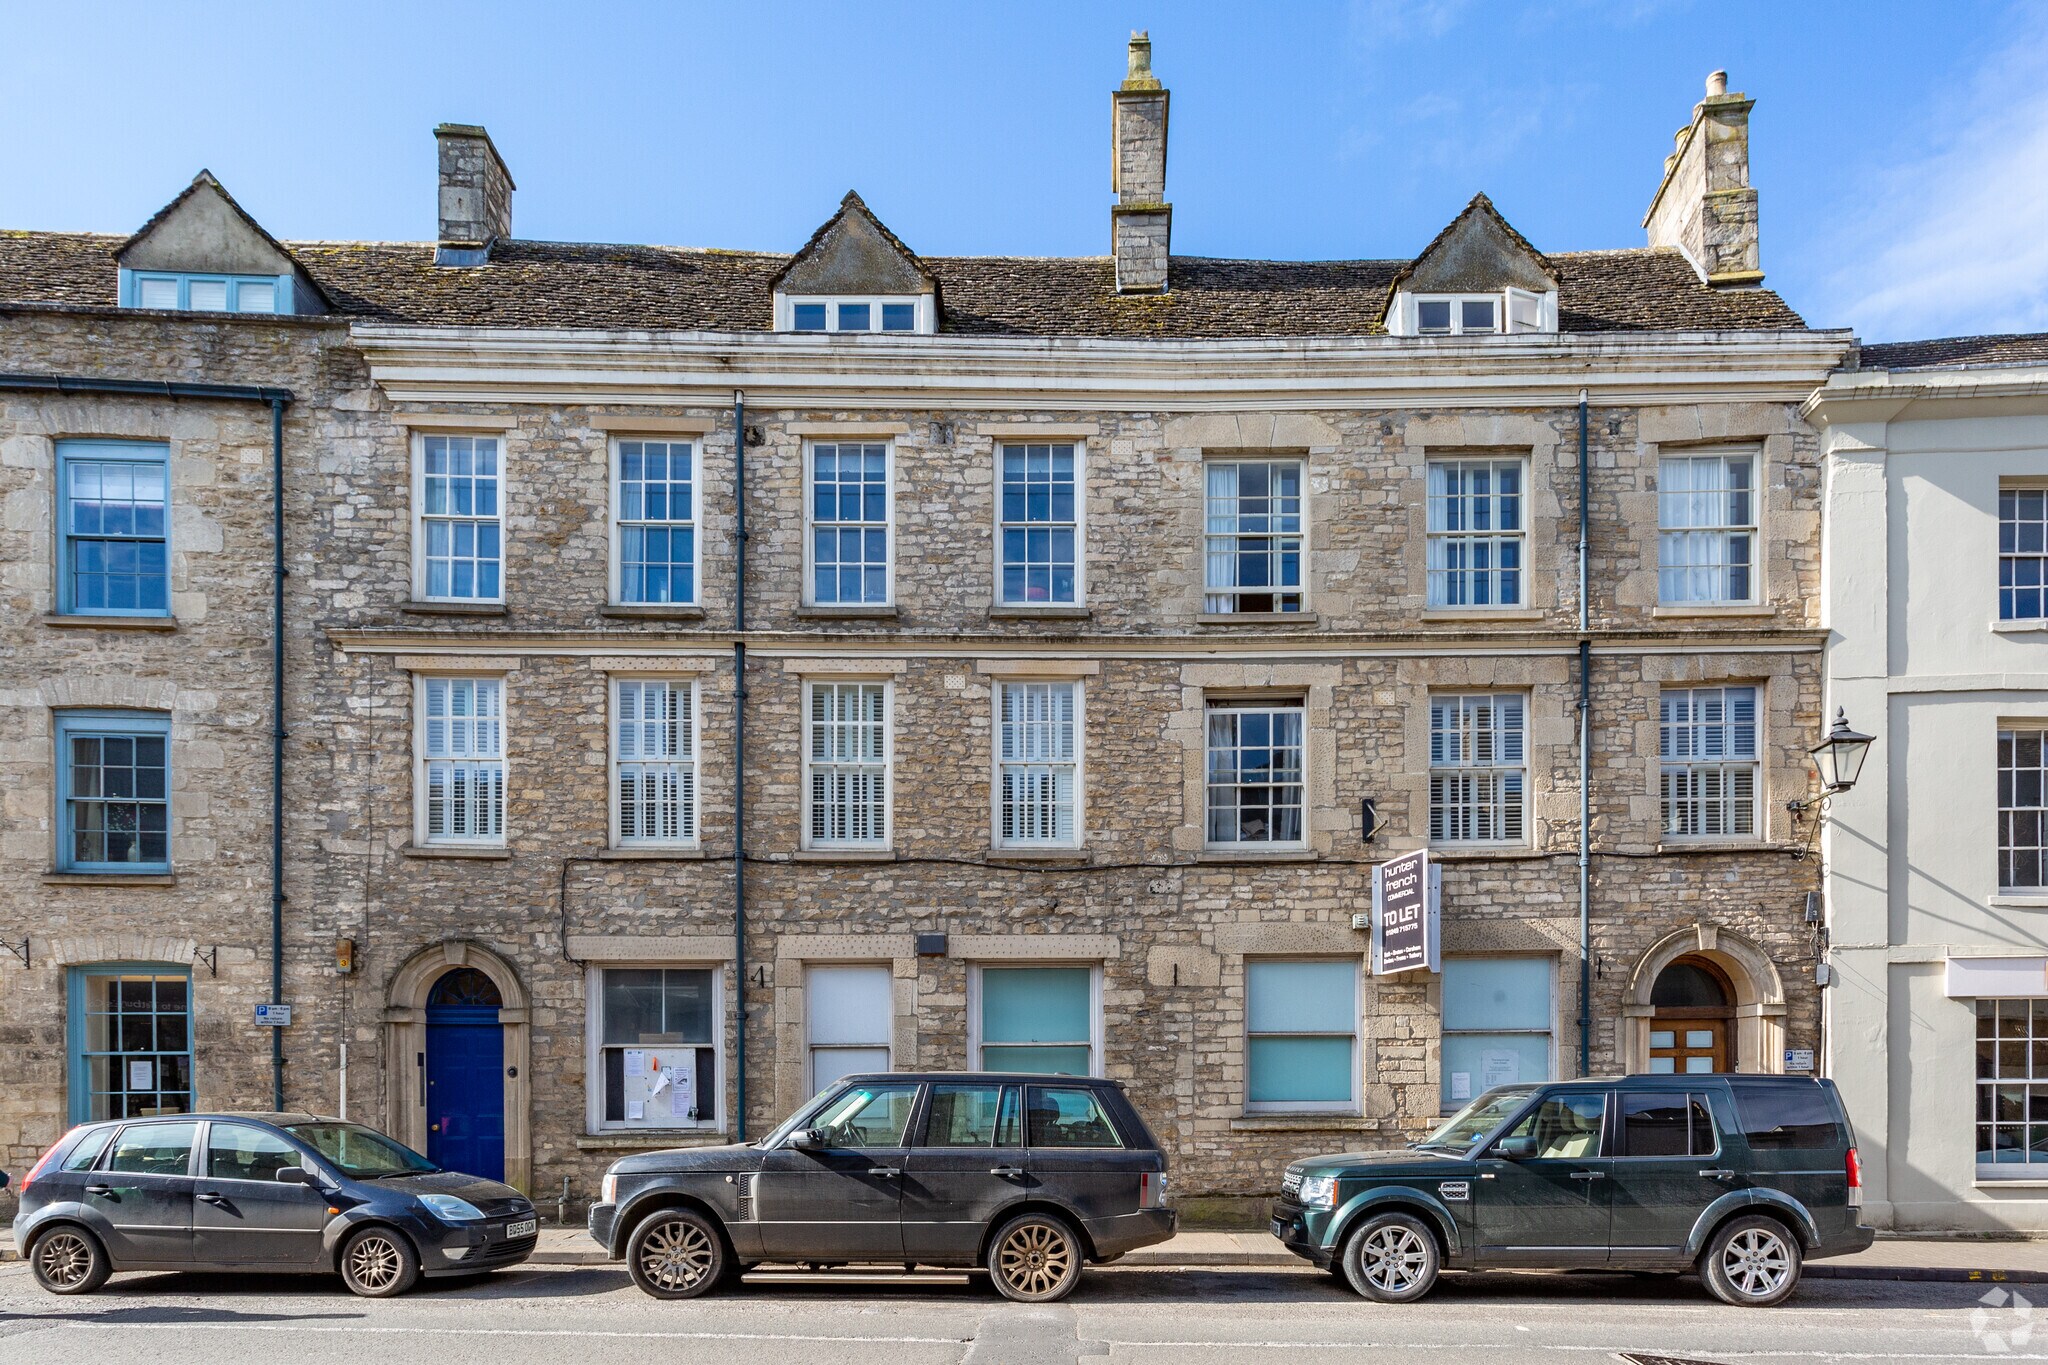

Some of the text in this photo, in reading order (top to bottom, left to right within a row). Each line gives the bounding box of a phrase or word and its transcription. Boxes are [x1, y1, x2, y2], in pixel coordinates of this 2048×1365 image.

[1385, 860, 1417, 878] hunter
[1386, 873, 1417, 892] french
[1384, 904, 1420, 926] TO LET
[258, 1006, 265, 1014] P
